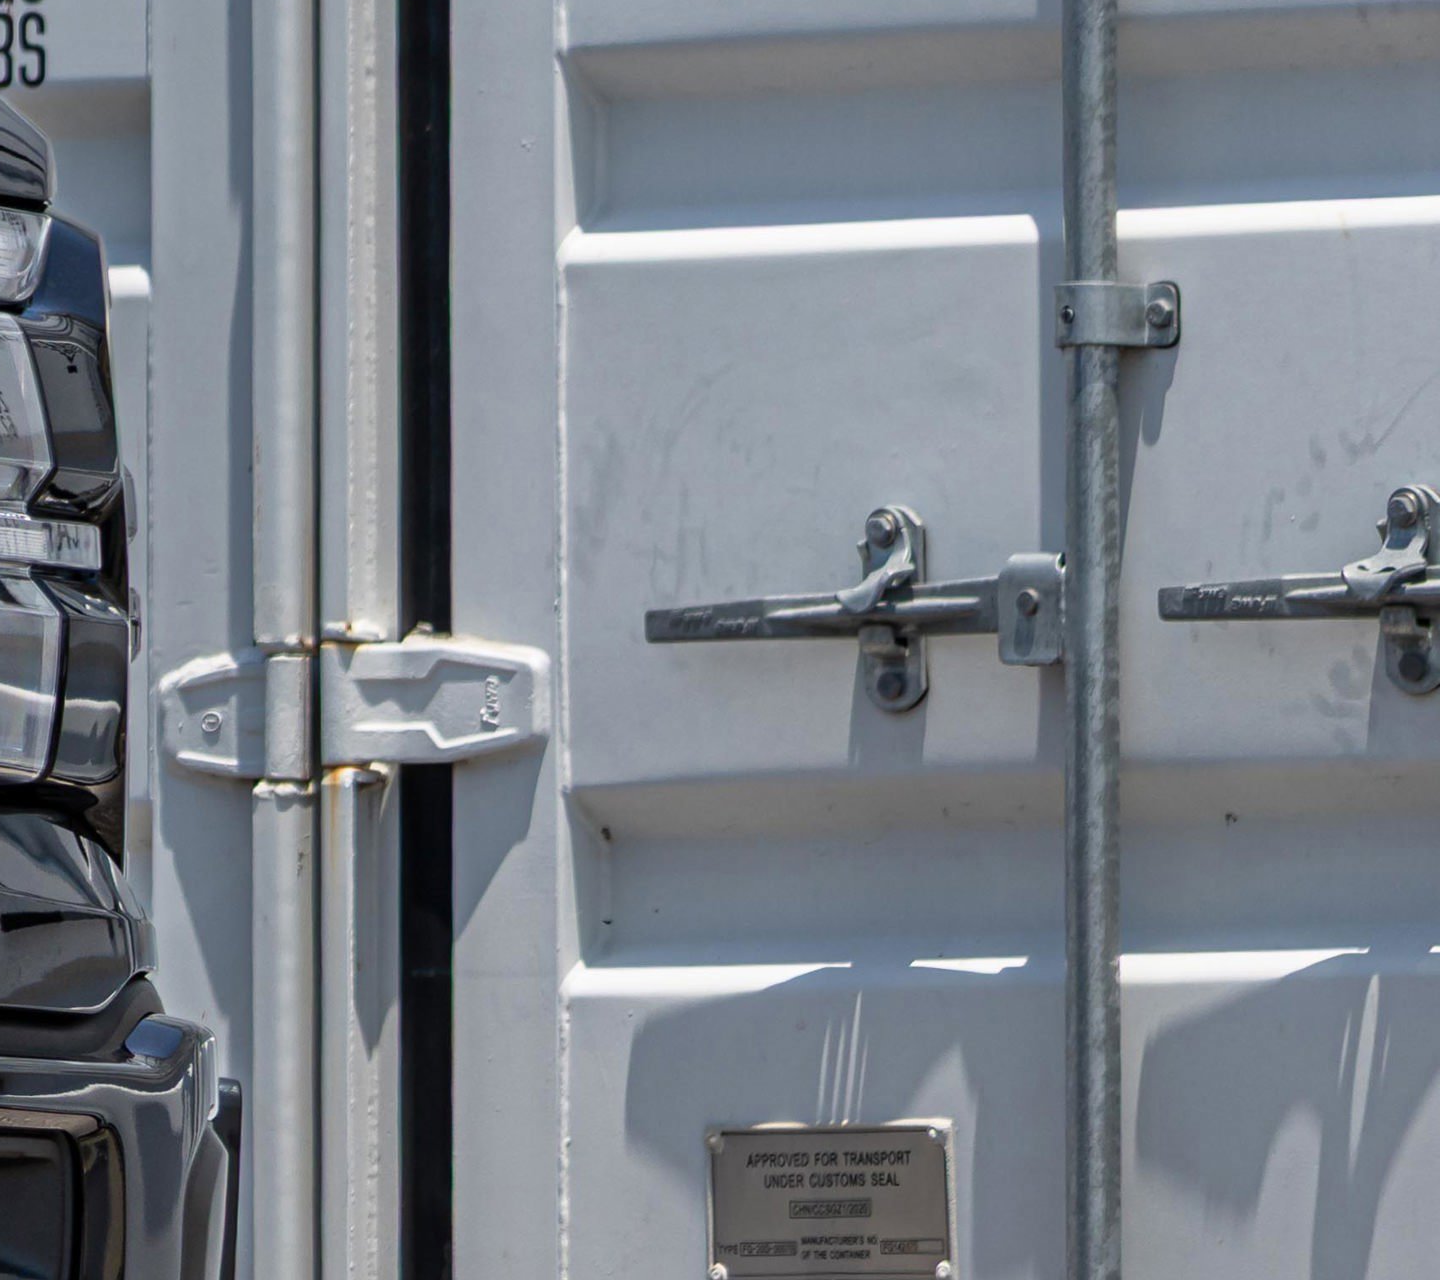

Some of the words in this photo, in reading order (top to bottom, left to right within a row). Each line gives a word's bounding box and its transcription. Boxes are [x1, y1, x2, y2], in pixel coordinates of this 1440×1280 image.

[746, 1153, 809, 1169] APPROVED
[815, 1152, 838, 1167] FOR
[843, 1150, 911, 1166] TRANSPORT
[764, 1174, 804, 1189] UNDER
[809, 1173, 865, 1188] CUSTOMS
[871, 1172, 900, 1187] SEAL
